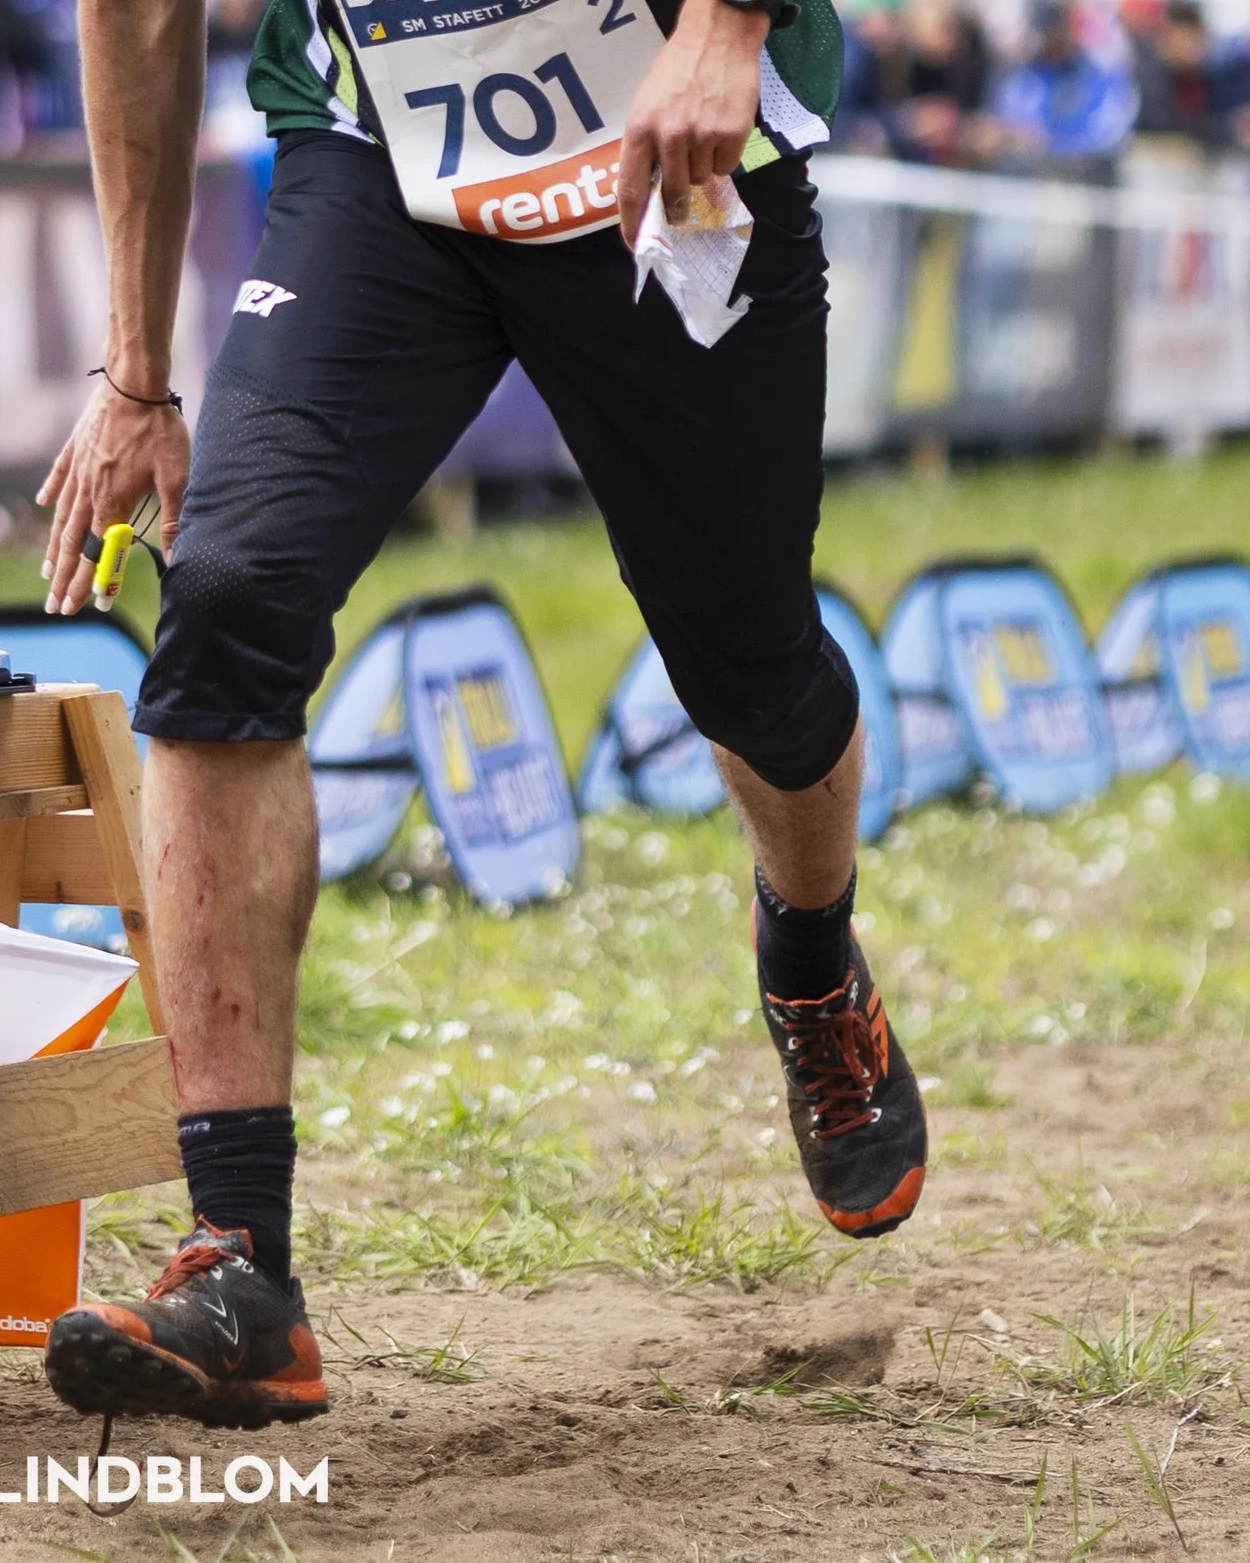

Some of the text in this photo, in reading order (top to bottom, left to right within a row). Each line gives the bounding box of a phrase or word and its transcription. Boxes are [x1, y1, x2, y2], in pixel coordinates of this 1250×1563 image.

[402, 19, 428, 33] SM
[435, 4, 504, 29] STAFETT
[404, 52, 606, 180] 701
